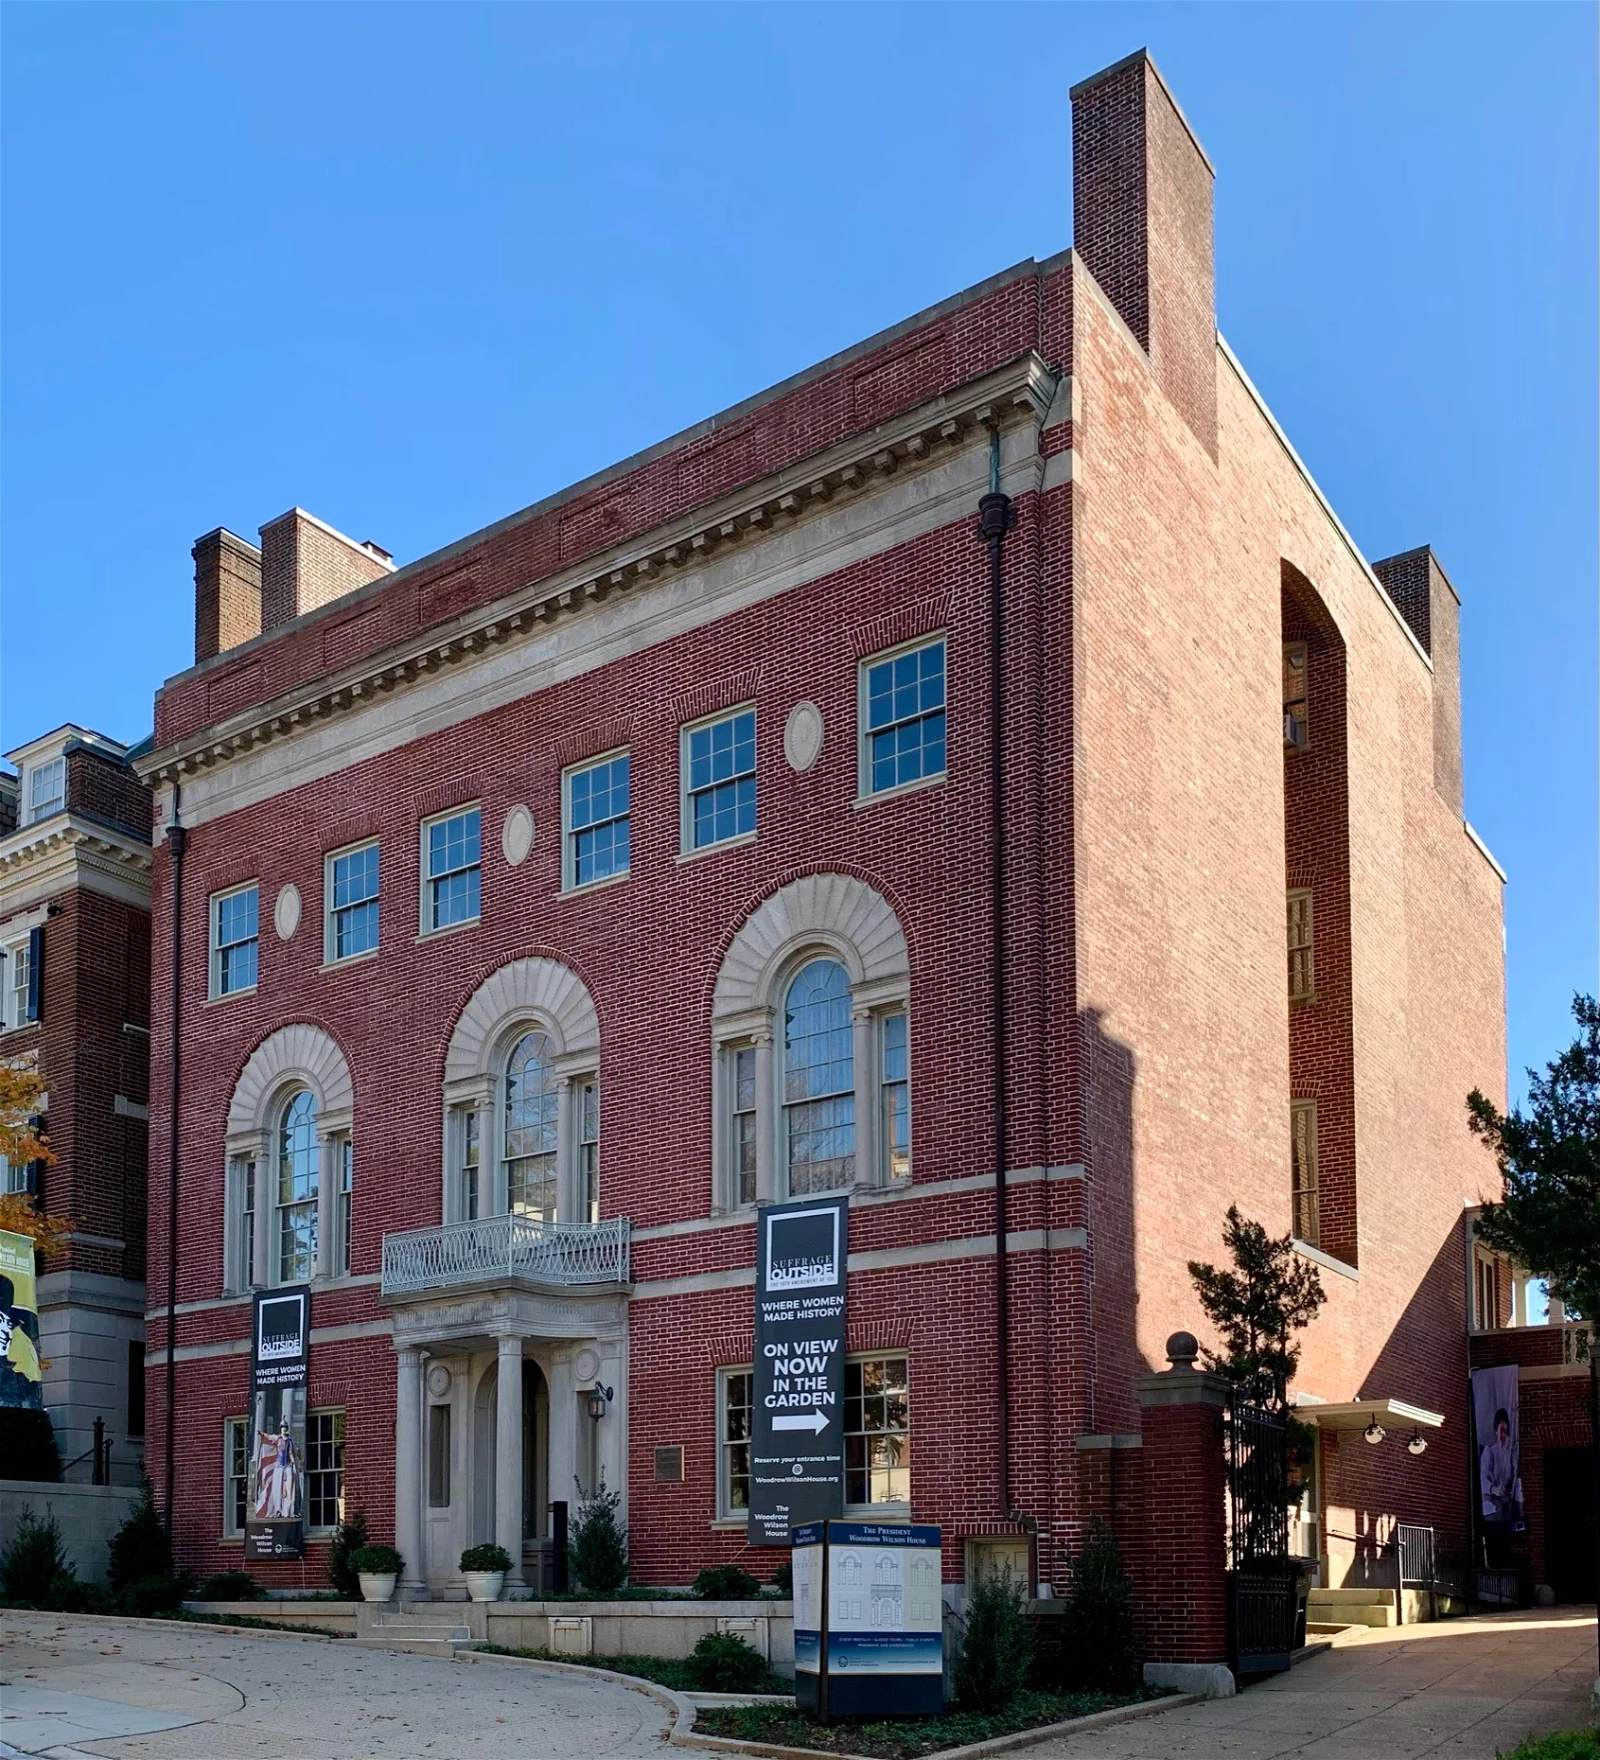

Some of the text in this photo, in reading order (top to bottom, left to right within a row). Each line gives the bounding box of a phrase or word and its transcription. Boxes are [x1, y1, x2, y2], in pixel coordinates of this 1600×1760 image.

[772, 1255, 833, 1269] SUFFRAGE
[771, 1264, 833, 1280] OUTSIDE
[762, 1296, 844, 1311] WHERE WOMEN
[764, 1307, 841, 1322] MADE HISTORY
[263, 1332, 299, 1341] SUFFRAGE
[262, 1339, 300, 1351] OUTSIDE
[763, 1339, 838, 1357] ON VIEW
[256, 1365, 306, 1376] WHERE WOMEN
[774, 1356, 828, 1376] NOW
[277, 1374, 304, 1383] HISTORY
[773, 1376, 827, 1392] IN THE
[764, 1391, 835, 1408] GARDEN
